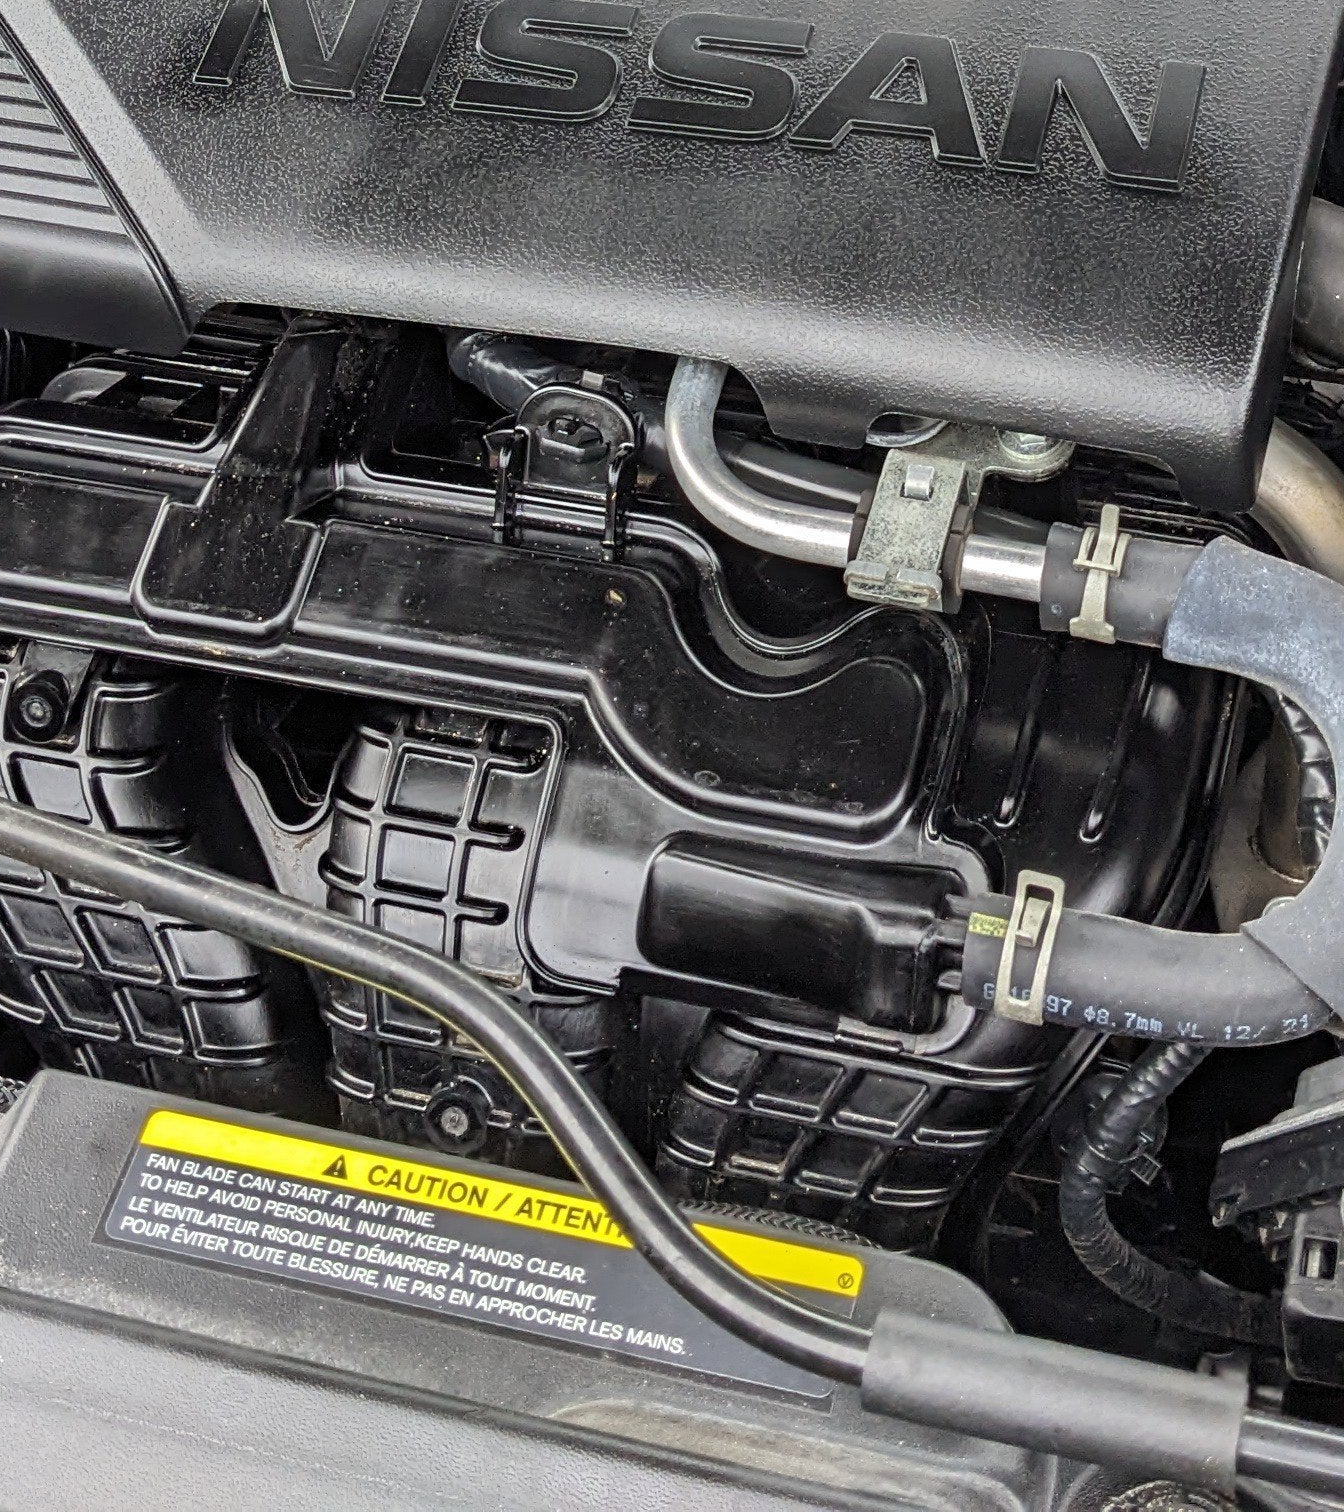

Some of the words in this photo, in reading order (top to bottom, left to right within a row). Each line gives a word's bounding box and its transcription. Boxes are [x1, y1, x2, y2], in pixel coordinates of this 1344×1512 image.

[139, 1172, 163, 1191] TO
[163, 1178, 209, 1199] HELP
[208, 1188, 261, 1211] AVOID
[262, 1199, 352, 1233] PERSONAL
[460, 1242, 525, 1270] HANDS
[525, 1257, 587, 1284] CLEAR.
[145, 1152, 180, 1173] FAN
[180, 1160, 238, 1185] BLADE
[238, 1173, 276, 1193] CAN
[277, 1181, 332, 1204] START
[330, 1193, 355, 1209] AT
[354, 1198, 393, 1217] ANY
[395, 1205, 435, 1228] TIME.
[367, 1164, 489, 1209] CAUTION
[514, 1197, 623, 1238] ATTENT
[118, 1215, 171, 1240] POUR
[169, 1222, 229, 1253] ÉVITER
[231, 1239, 287, 1265] TOUTE
[286, 1252, 379, 1289] BLESSURE,
[382, 1273, 410, 1293] NE
[409, 1279, 447, 1301] PAS
[447, 1288, 475, 1307] EN
[474, 1295, 588, 1333] APPROCHER
[587, 1319, 624, 1341] LES
[625, 1327, 687, 1356] MAINS.
[126, 1195, 152, 1214] LE
[152, 1200, 260, 1237] VENTILATEUR
[260, 1223, 327, 1252] RISQUE
[326, 1238, 354, 1258] DE
[353, 1243, 451, 1279] DÉMARRER
[450, 1261, 465, 1283] À
[469, 1269, 516, 1292] TOUT
[515, 1280, 597, 1312] MOMENT.
